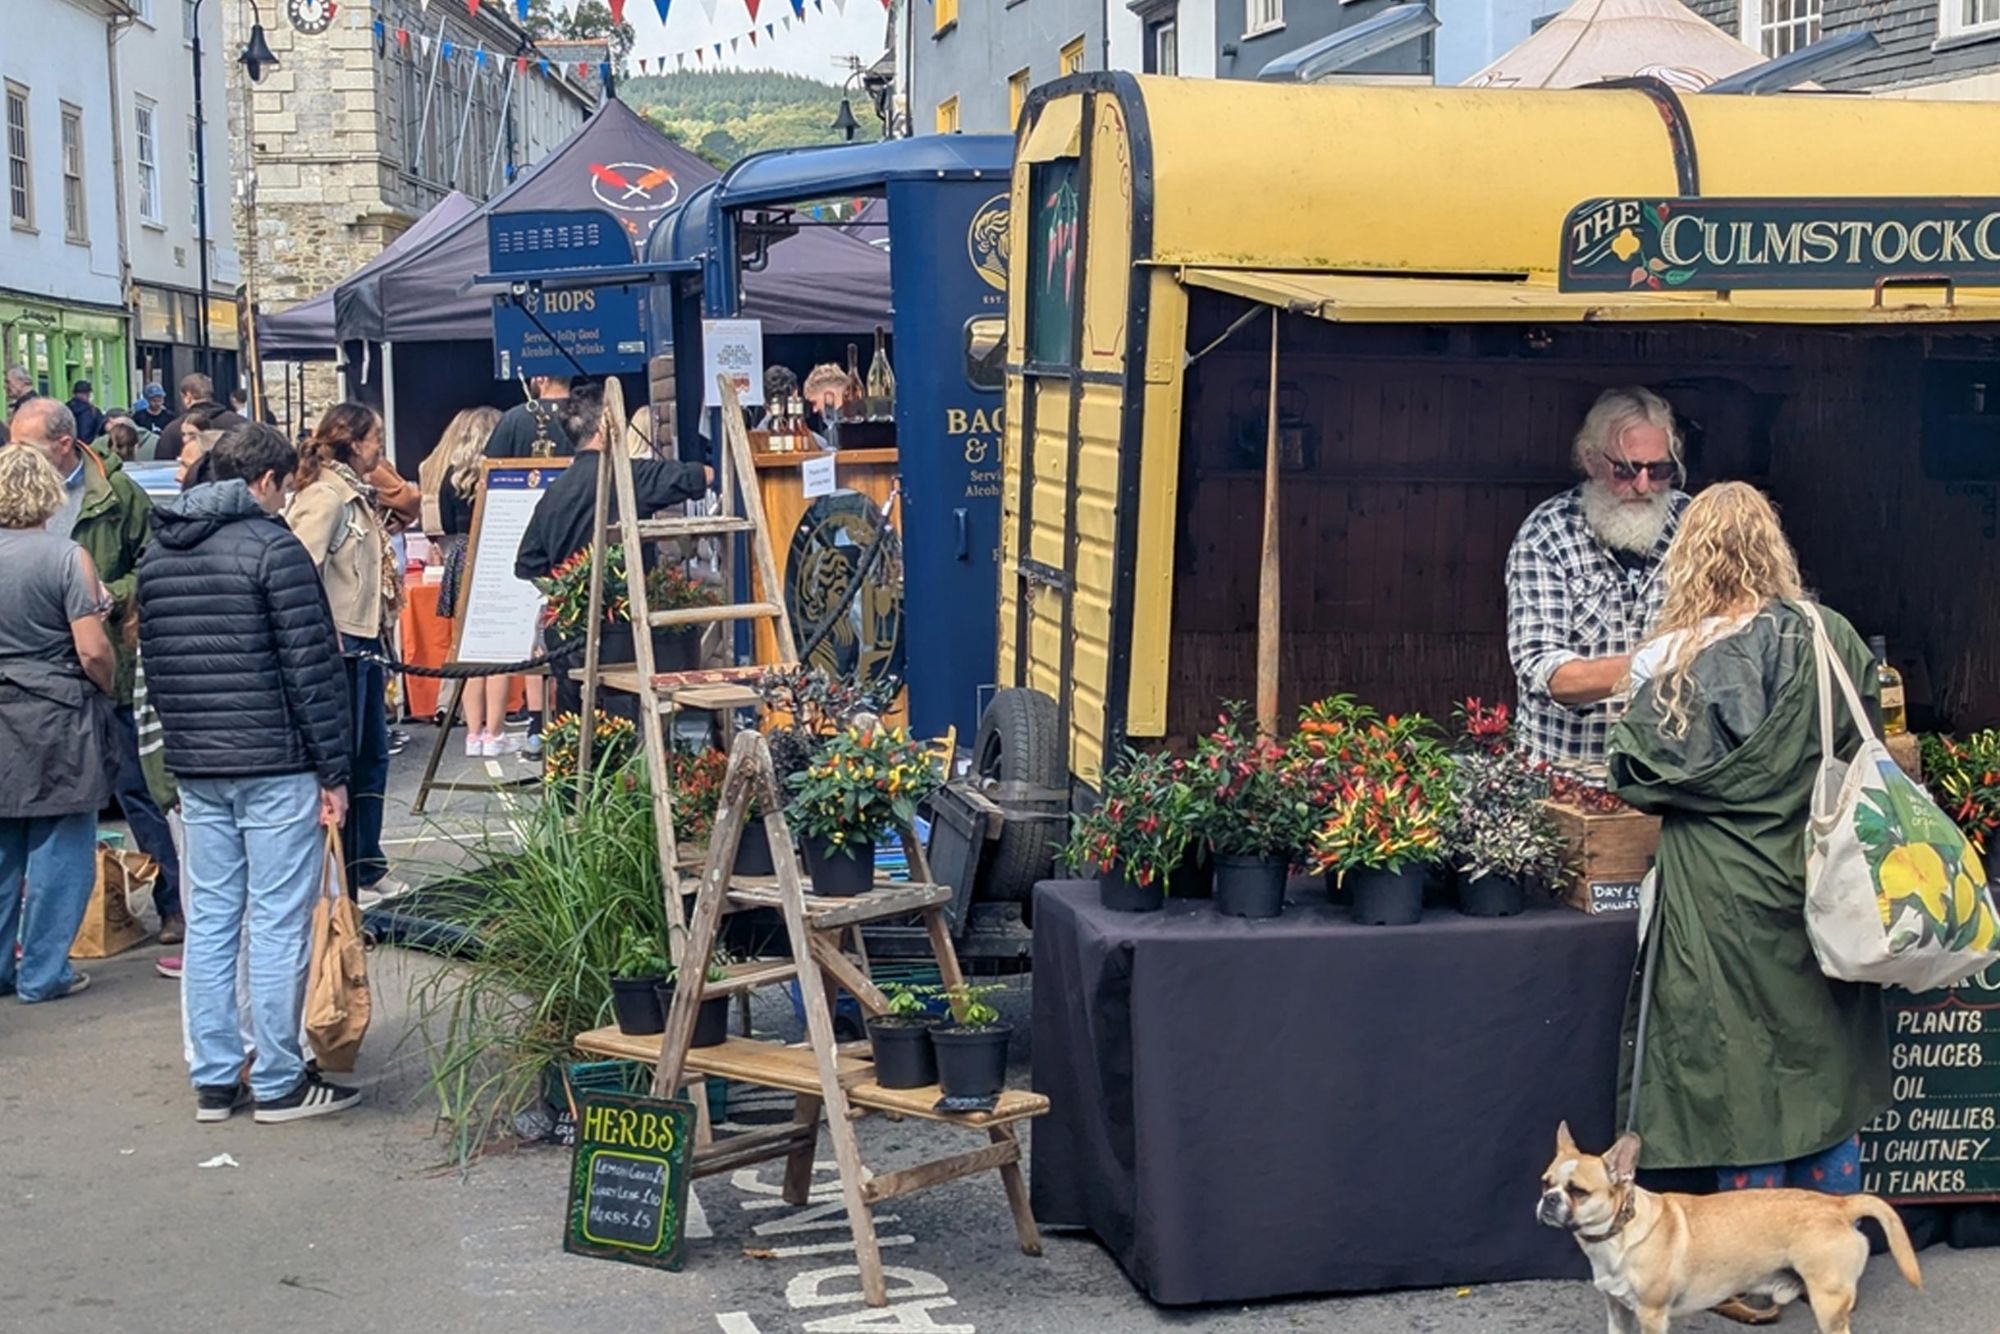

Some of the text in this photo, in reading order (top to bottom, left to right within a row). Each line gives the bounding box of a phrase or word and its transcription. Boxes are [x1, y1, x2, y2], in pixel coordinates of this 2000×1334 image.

[1572, 201, 1641, 252] THE
[526, 289, 596, 314] & HOPS
[578, 328, 600, 341] Good
[521, 345, 553, 358] Alcohol
[575, 342, 605, 355] Drinks
[964, 438, 988, 464] &
[1896, 1010, 1983, 1034] PLANTS
[1892, 1043, 1983, 1070] SAUCES
[1893, 1076, 1927, 1101] OIL
[583, 1105, 675, 1153] HERBS
[1860, 1106, 1996, 1132] ED CHILLIES
[1859, 1137, 1991, 1163] LI CHUTNEY
[1862, 1168, 1966, 1194] LI FLAKES
[590, 1205, 652, 1229] HERBS £5
